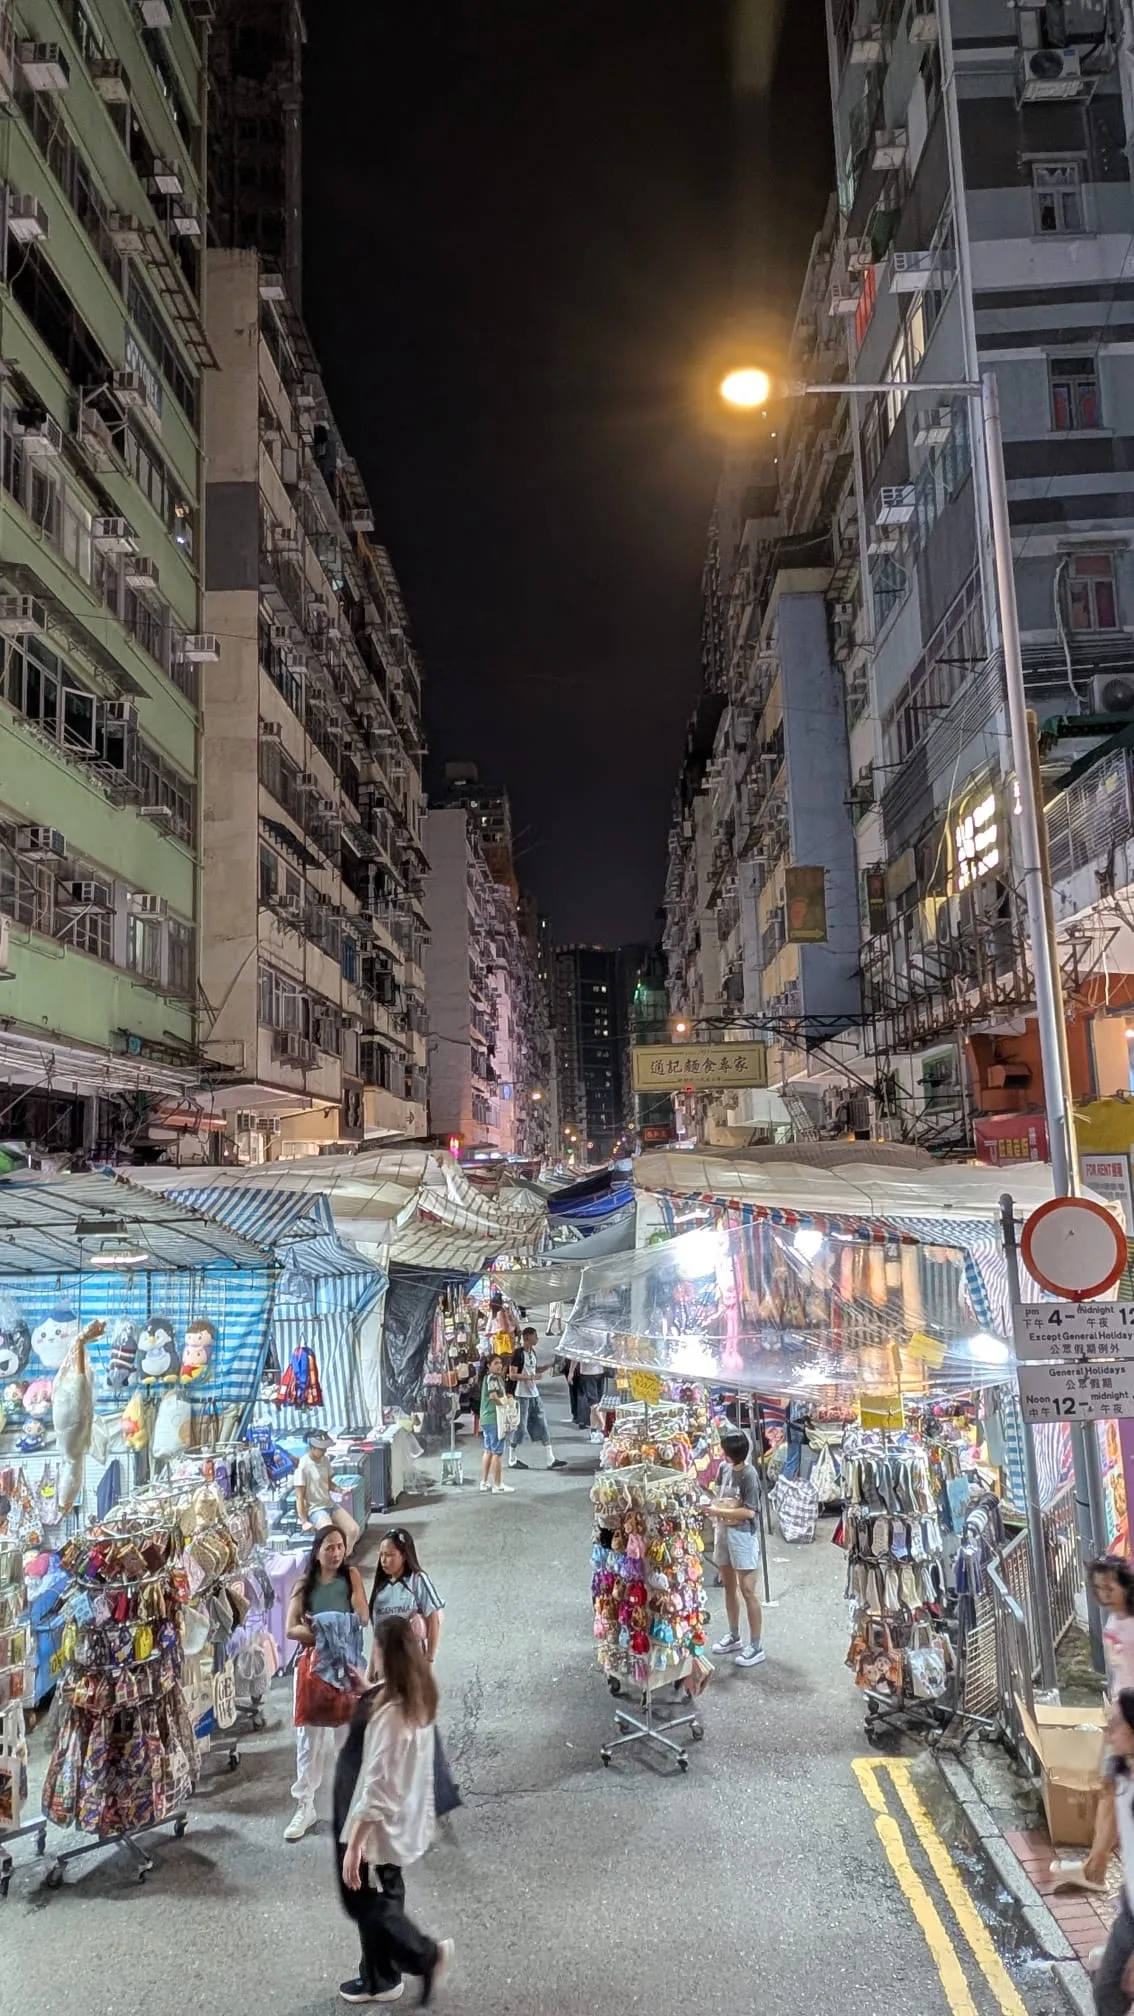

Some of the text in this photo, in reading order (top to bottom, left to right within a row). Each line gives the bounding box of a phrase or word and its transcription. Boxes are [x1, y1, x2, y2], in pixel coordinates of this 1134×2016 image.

[1025, 1308, 1040, 1317] pm
[1023, 1318, 1109, 1329] 下午 午夜
[1029, 1333, 1061, 1342] Except
[1062, 1332, 1098, 1341] General
[1049, 1366, 1126, 1377] General Holidays
[1026, 1395, 1050, 1404] Noon
[1091, 1391, 1129, 1401] midnight
[1029, 1404, 1123, 1417] 中午 午夜
